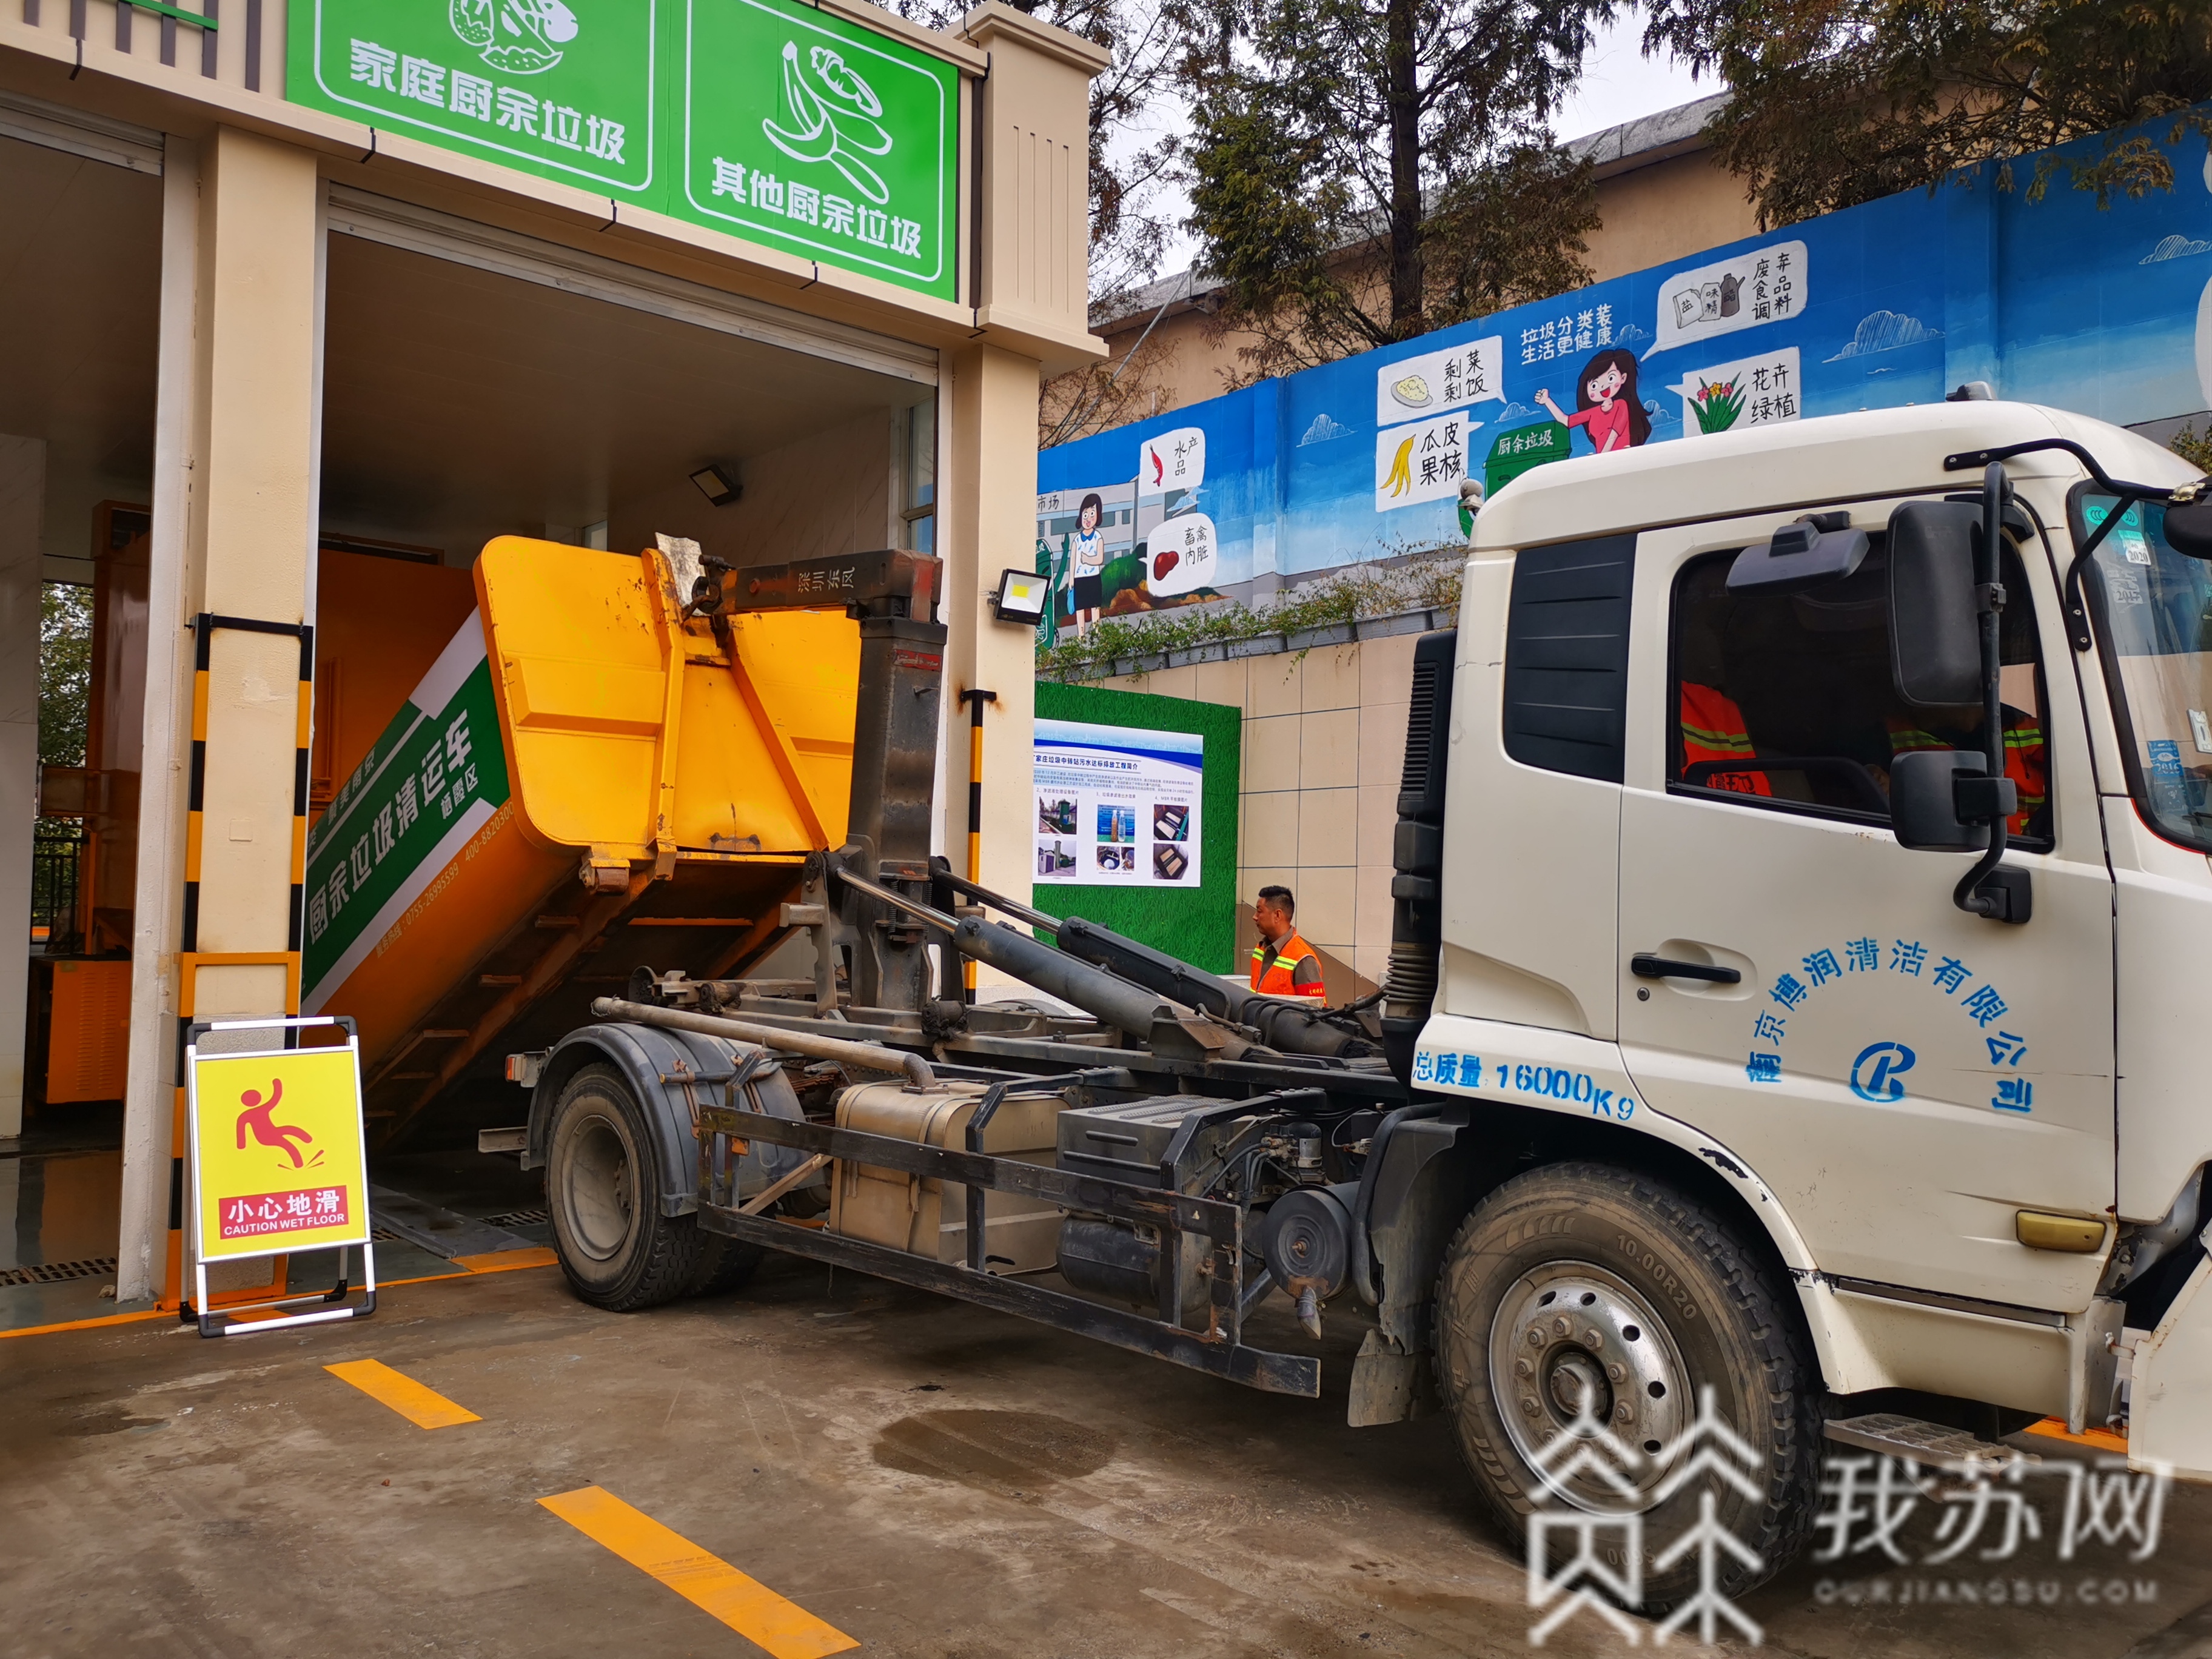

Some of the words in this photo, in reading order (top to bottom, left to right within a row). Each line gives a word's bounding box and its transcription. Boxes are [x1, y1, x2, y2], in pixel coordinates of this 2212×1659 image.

[349, 38, 625, 166] 家庭厨余垃圾
[711, 156, 922, 260] 其他厨余垃圾
[1753, 252, 1791, 280] 废弃
[1752, 275, 1791, 300] 食品
[1681, 298, 1694, 313] 盐
[1751, 293, 1792, 320] 调料
[1521, 326, 1613, 366] 生活更健康
[1444, 349, 1484, 382] 剩菜
[1752, 363, 1789, 392] 花卉
[1443, 373, 1489, 403] 剩饭
[1751, 392, 1797, 424] 绿植
[1175, 437, 1198, 459] 水产
[1420, 421, 1460, 454] 瓜皮
[1498, 429, 1553, 455] 厨余垃圾
[1175, 459, 1185, 476] 品
[1420, 449, 1462, 486] 果核
[1037, 495, 1059, 512] 市场
[1184, 525, 1208, 546] 畜禽
[1185, 545, 1209, 566] 内脏
[2129, 549, 2149, 563] 2020
[1033, 754, 1138, 770] 家庄垃圾中转站污水达标排放工程简介
[440, 762, 478, 820] 栖霞区
[310, 708, 473, 945] 厨余垃圾清运车
[465, 801, 514, 862] 400-8820300
[1744, 936, 2034, 1113] 南京博润清洁有限公司
[1413, 1051, 1482, 1088] 总质量
[228, 1190, 340, 1224] 小心地滑
[224, 1221, 278, 1236] CAUTION
[280, 1218, 305, 1229] WET
[307, 1213, 345, 1226] FLOOR
[1617, 1235, 1697, 1319] 10.00R20
